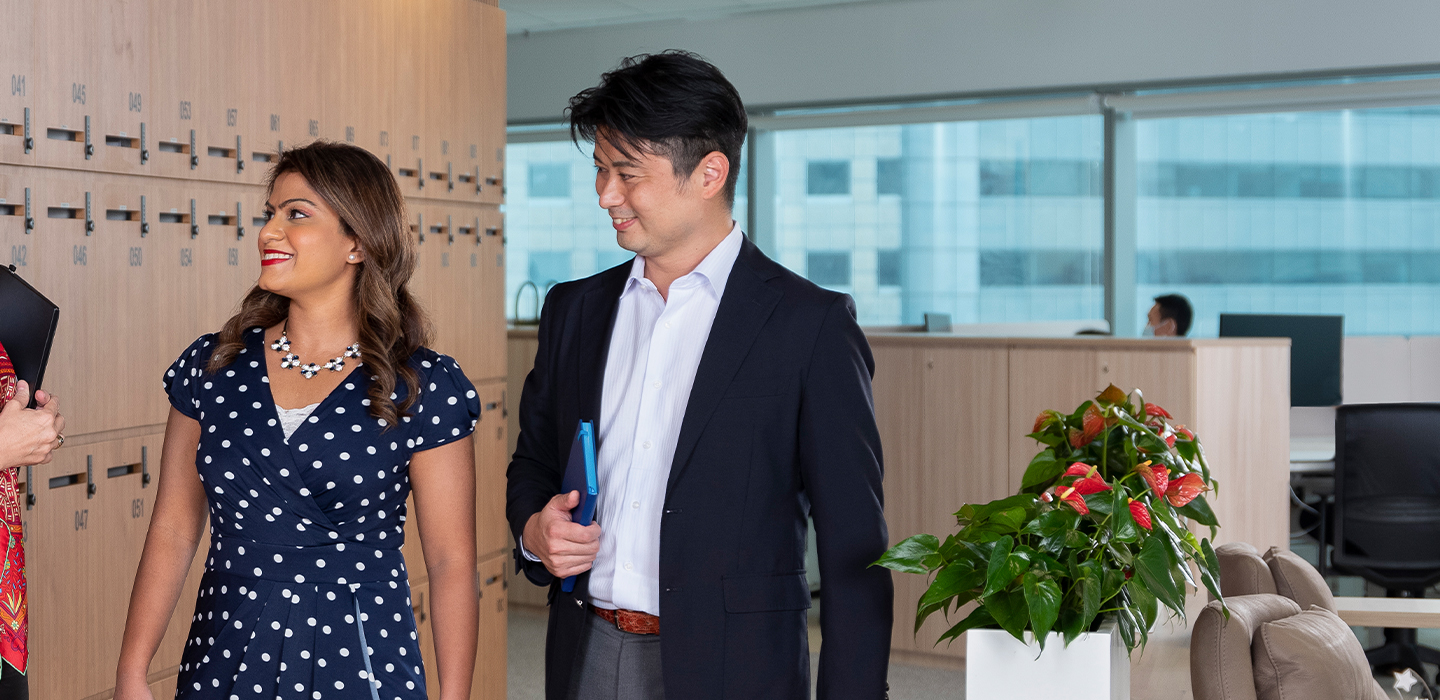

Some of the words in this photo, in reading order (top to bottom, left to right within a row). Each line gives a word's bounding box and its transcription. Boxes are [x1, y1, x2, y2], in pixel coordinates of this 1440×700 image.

[11, 74, 27, 97] 041
[72, 82, 87, 105] 045
[129, 91, 142, 113] 049
[11, 245, 28, 267] 042
[73, 245, 88, 267] 046
[129, 247, 143, 267] 050
[74, 509, 89, 531] 047
[132, 499, 145, 519] 051
